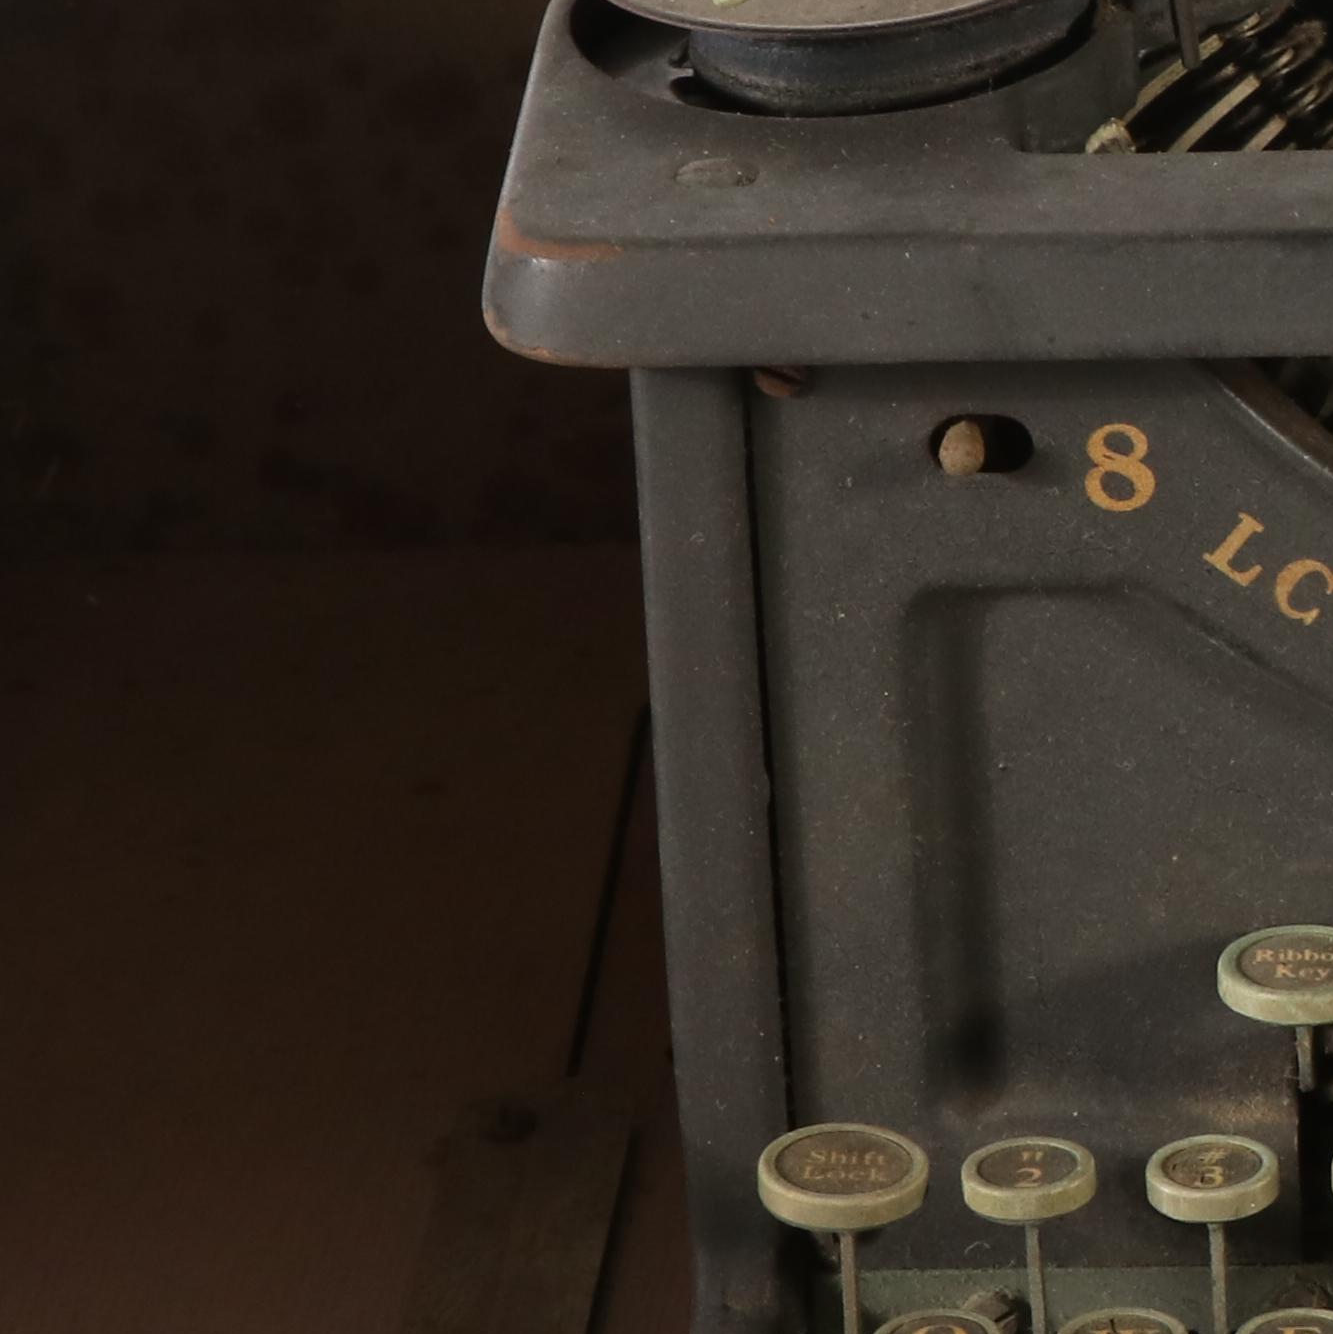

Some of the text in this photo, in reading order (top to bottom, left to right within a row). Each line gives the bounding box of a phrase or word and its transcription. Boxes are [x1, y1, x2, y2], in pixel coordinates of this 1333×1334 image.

[1084, 423, 1156, 513] 8
[1203, 512, 1268, 588] L
[1275, 963, 1329, 981] Key
[806, 1149, 890, 1165] Shift
[803, 1166, 887, 1182] Lock
[1015, 1169, 1043, 1188] 2
[1195, 1168, 1225, 1188] 3
